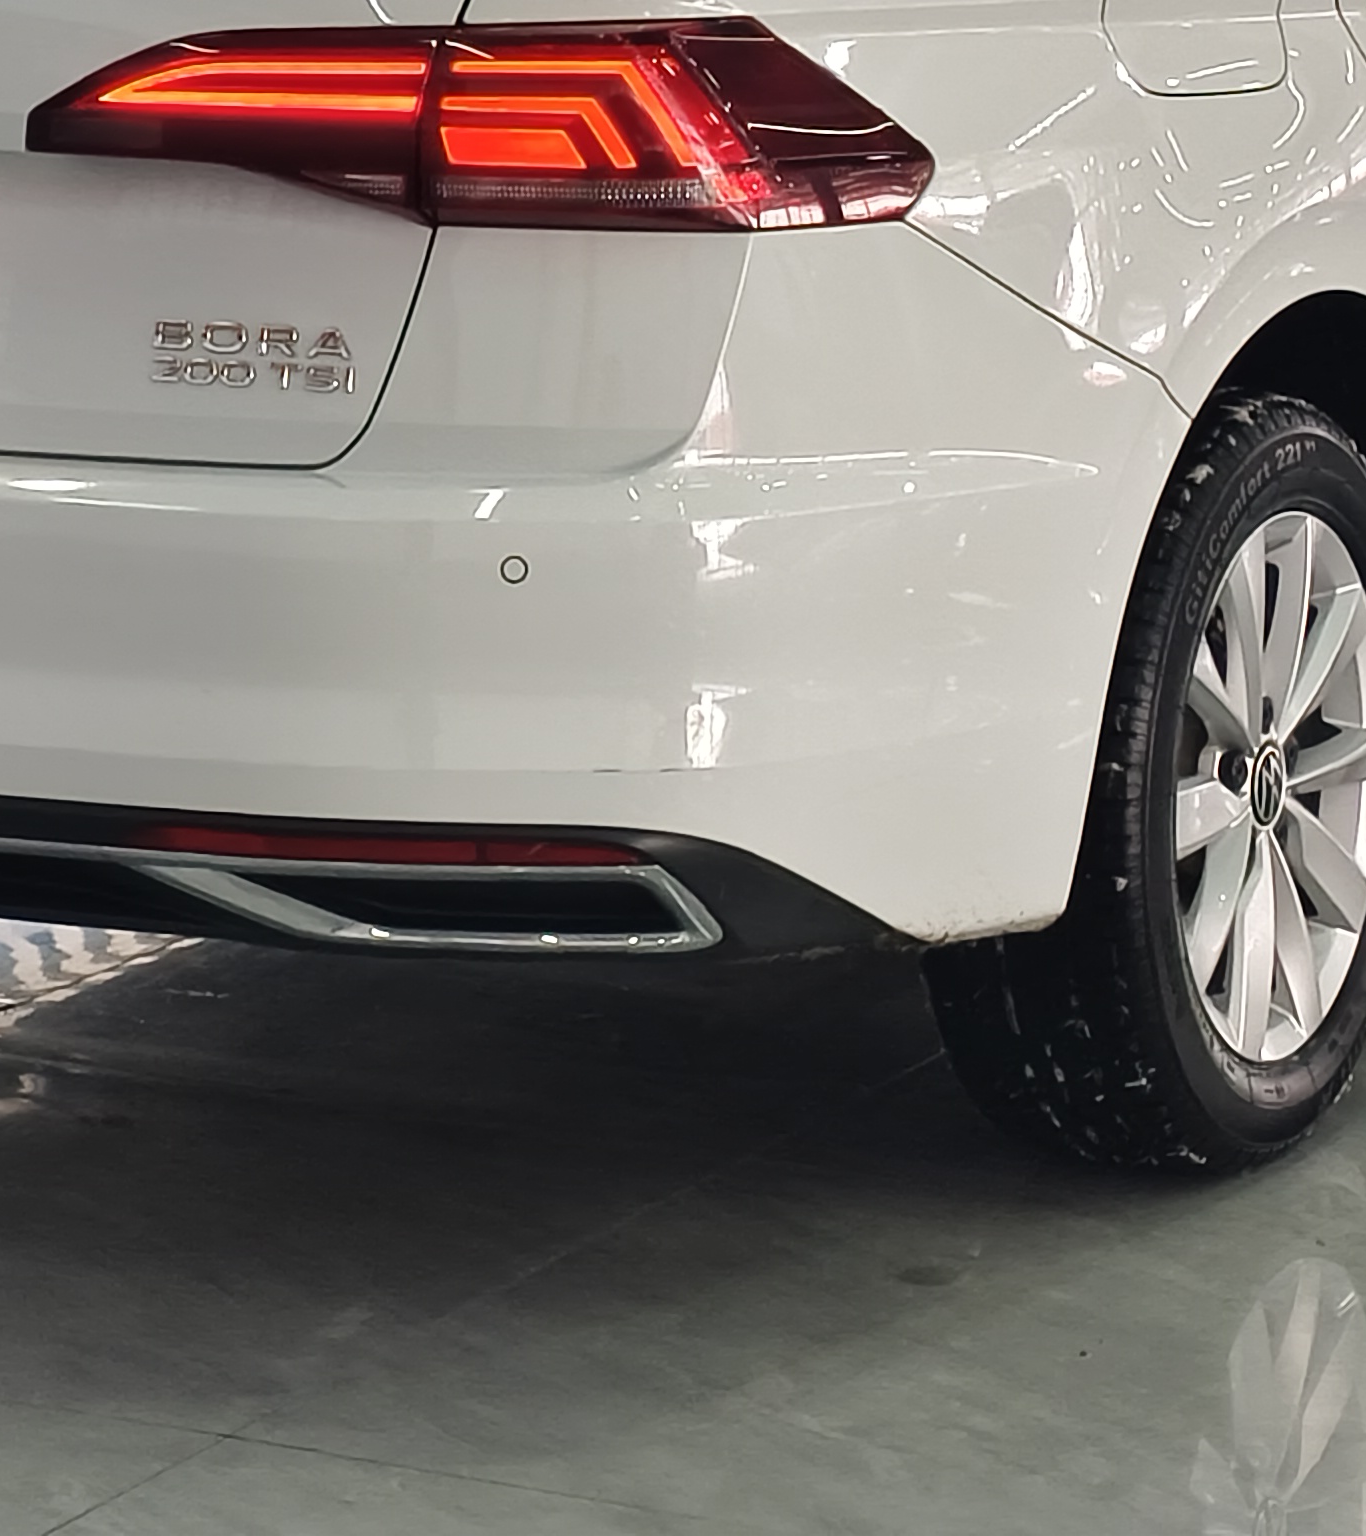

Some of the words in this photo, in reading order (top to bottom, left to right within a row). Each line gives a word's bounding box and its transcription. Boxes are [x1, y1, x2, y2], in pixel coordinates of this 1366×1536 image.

[152, 319, 351, 360] BORA
[151, 355, 256, 388] 200
[270, 361, 356, 394] TSI
